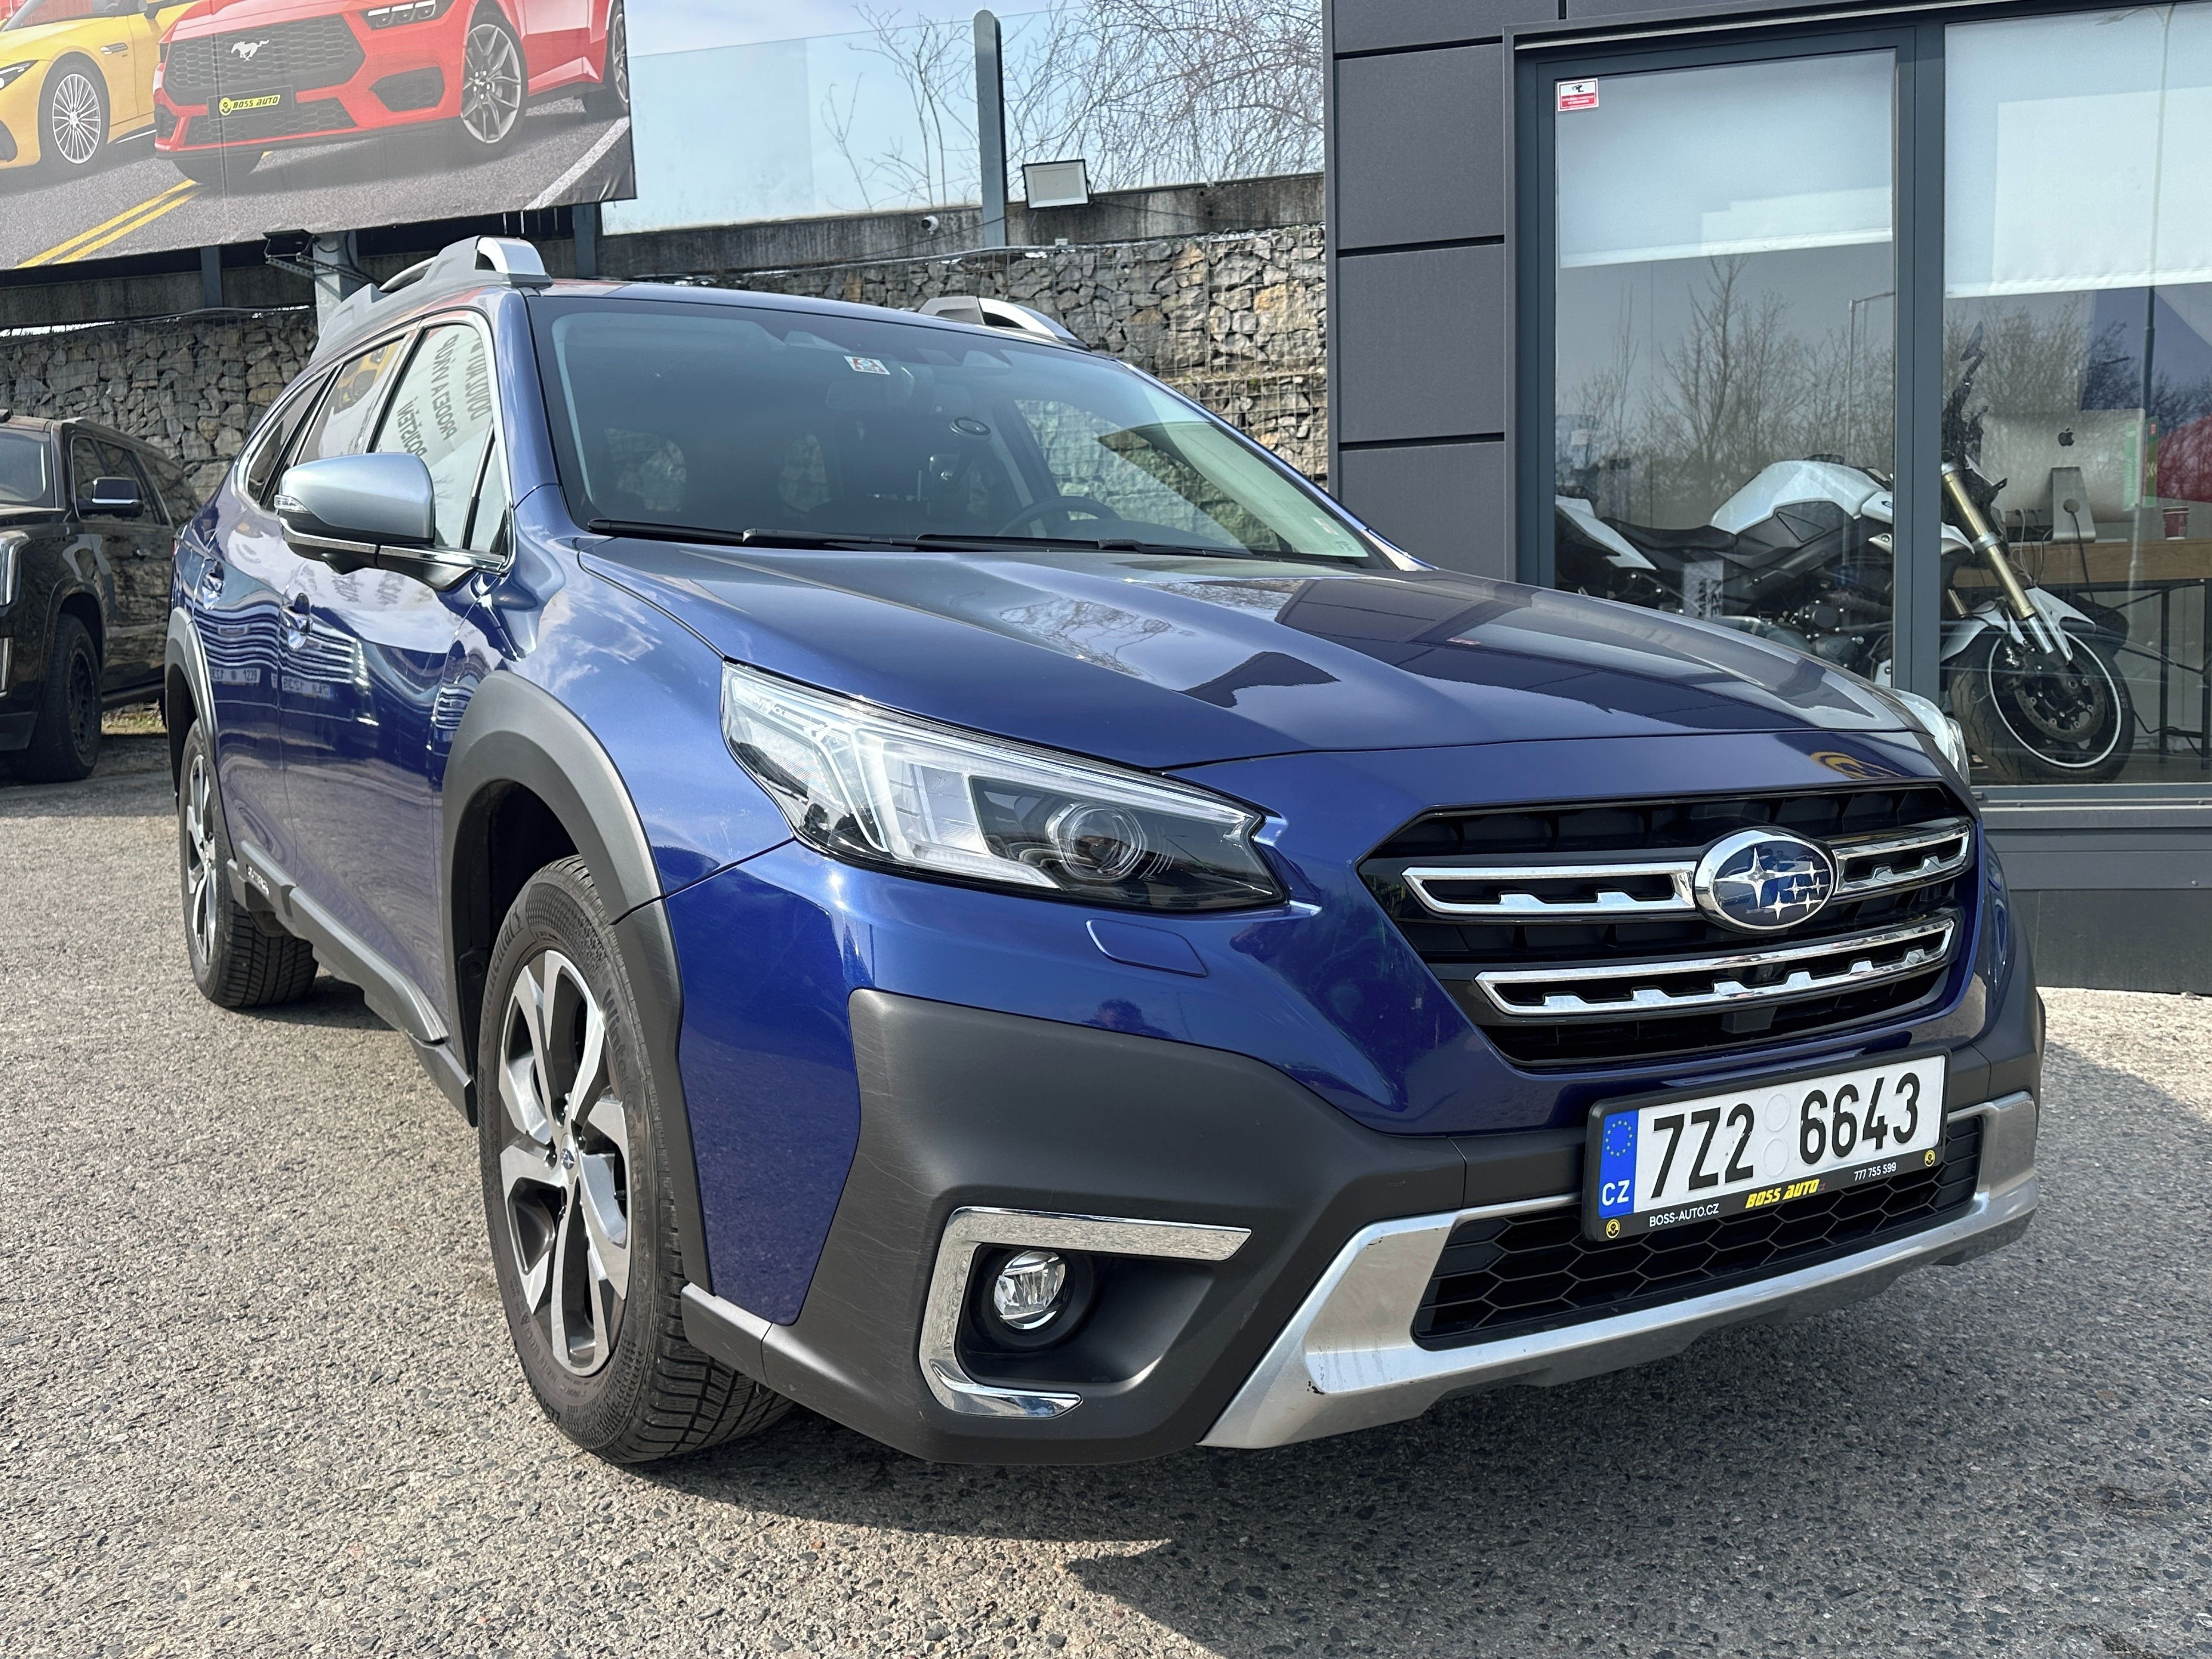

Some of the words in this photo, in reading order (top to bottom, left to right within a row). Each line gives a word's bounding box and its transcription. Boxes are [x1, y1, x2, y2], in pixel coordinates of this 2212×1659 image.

[233, 100, 254, 109] BOSS
[256, 97, 278, 106] AUTO
[1651, 1103, 1755, 1199] 7Z2
[1799, 1073, 1921, 1165] 6643
[1854, 1169, 1866, 1181] 777
[1868, 1165, 1881, 1177] 755
[1882, 1161, 1897, 1174] 599
[1602, 1180, 1630, 1206] CZ
[1745, 1187, 1781, 1209] BOSS
[1782, 1178, 1820, 1200] AUTO
[1649, 1203, 1719, 1227] BOSS-AUTO.CZ
